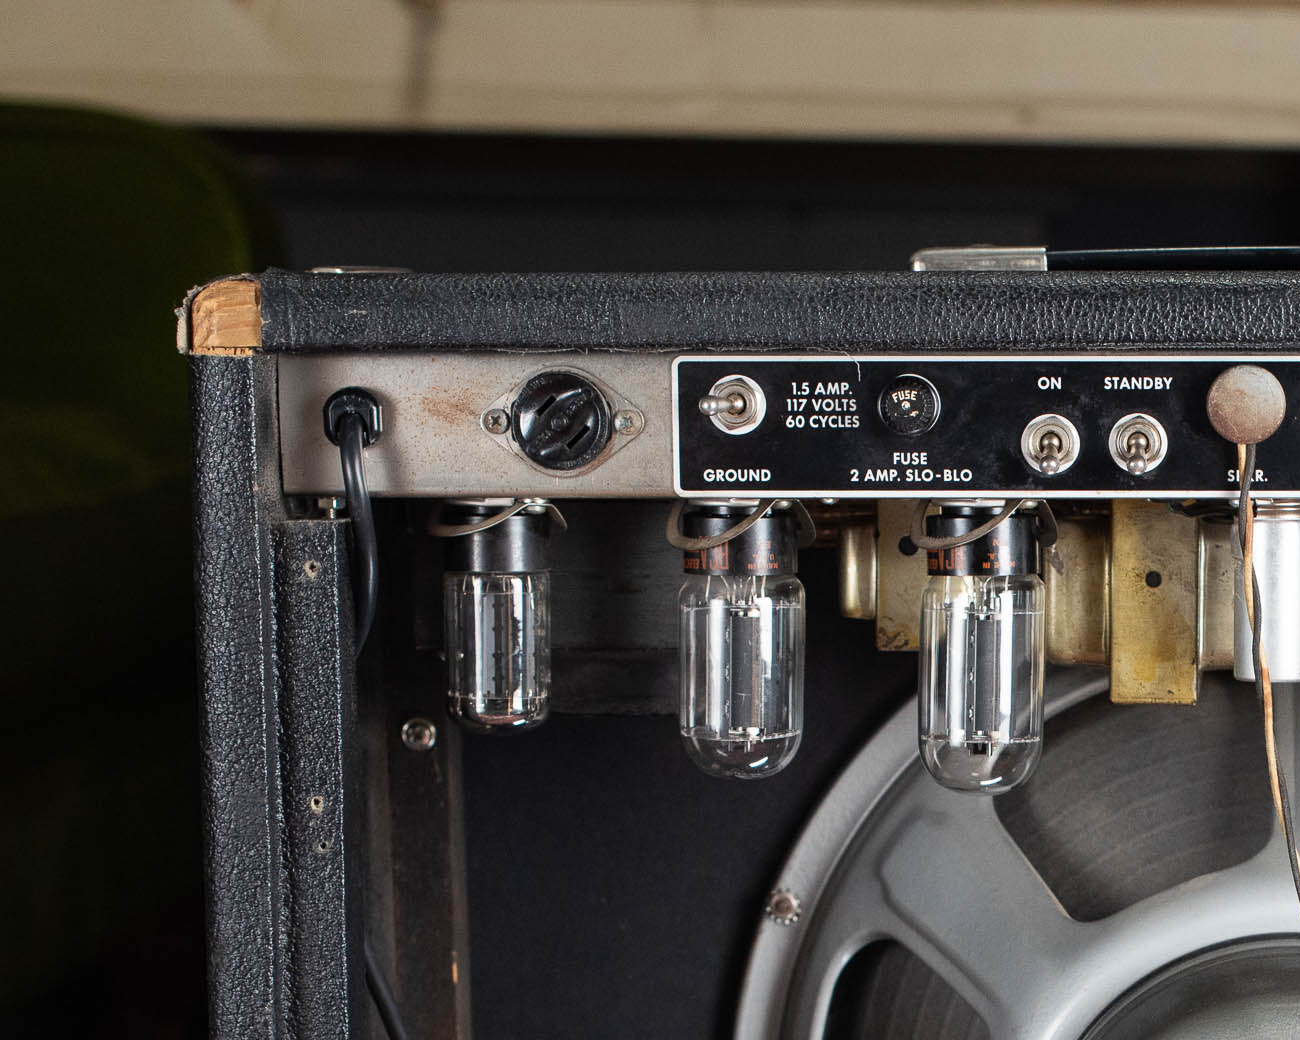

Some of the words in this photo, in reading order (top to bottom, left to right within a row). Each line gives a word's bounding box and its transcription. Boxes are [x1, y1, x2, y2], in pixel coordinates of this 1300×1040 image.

[791, 382, 810, 395] 1.5
[814, 382, 853, 395] AMP.
[1037, 377, 1062, 390] ON
[1103, 377, 1173, 390] STANDBY
[891, 389, 918, 403] FUSE
[786, 399, 807, 412] 117
[811, 399, 857, 412] VOLTS
[786, 415, 806, 428] 60
[809, 415, 860, 428] CYCLES
[893, 452, 928, 465] FUSE
[703, 469, 771, 482] GROUND
[850, 469, 859, 482] 2
[864, 469, 901, 482] AMP.
[905, 469, 973, 482] SLO-BLO
[1227, 469, 1268, 482] SR.
